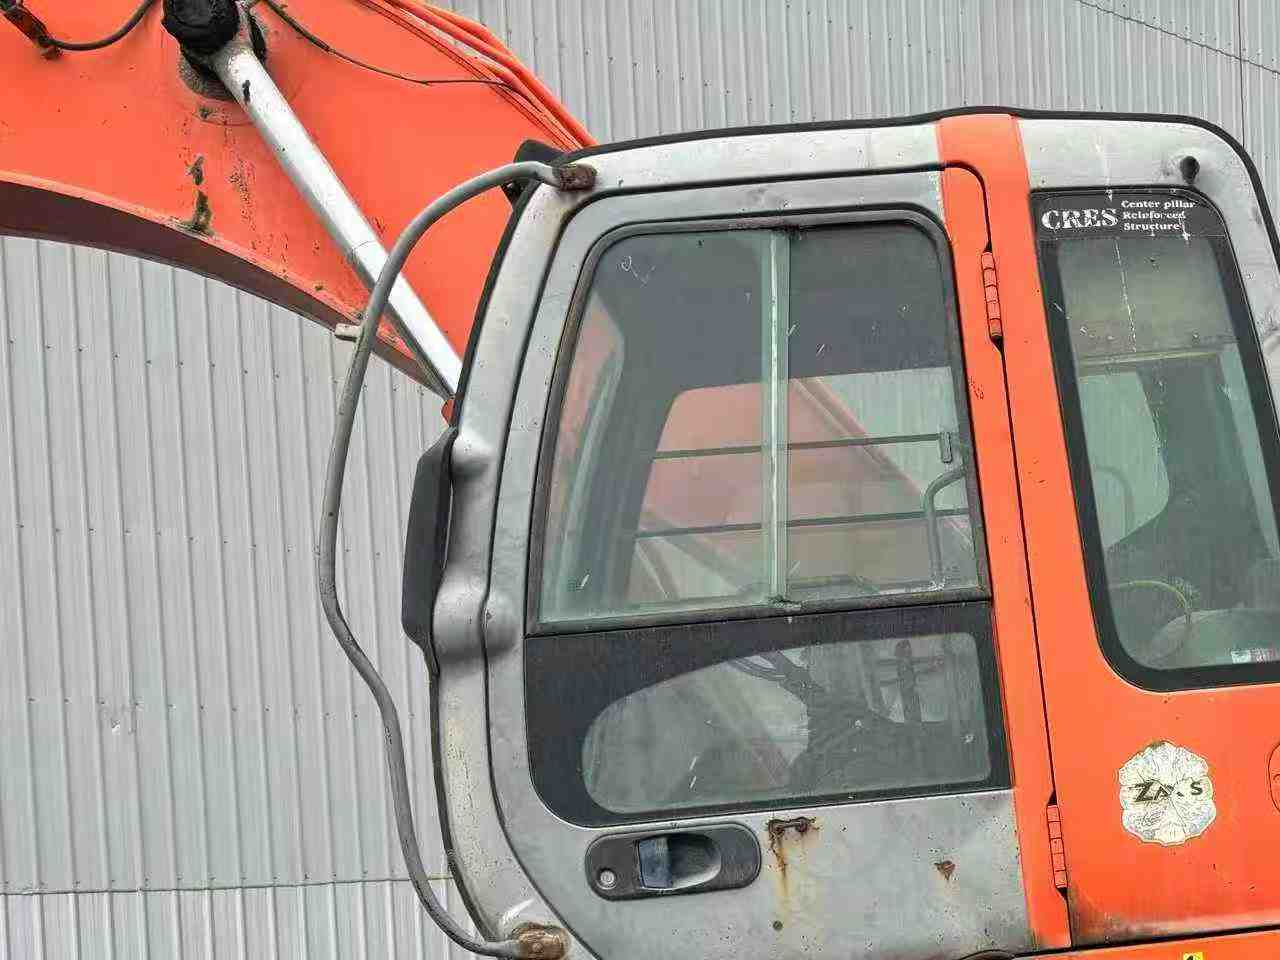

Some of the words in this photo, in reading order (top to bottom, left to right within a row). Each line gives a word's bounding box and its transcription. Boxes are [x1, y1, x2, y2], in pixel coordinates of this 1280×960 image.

[1121, 200, 1160, 209] Center
[1163, 199, 1196, 210] pillar
[1041, 208, 1119, 229] CRES
[1123, 221, 1181, 231] Structure
